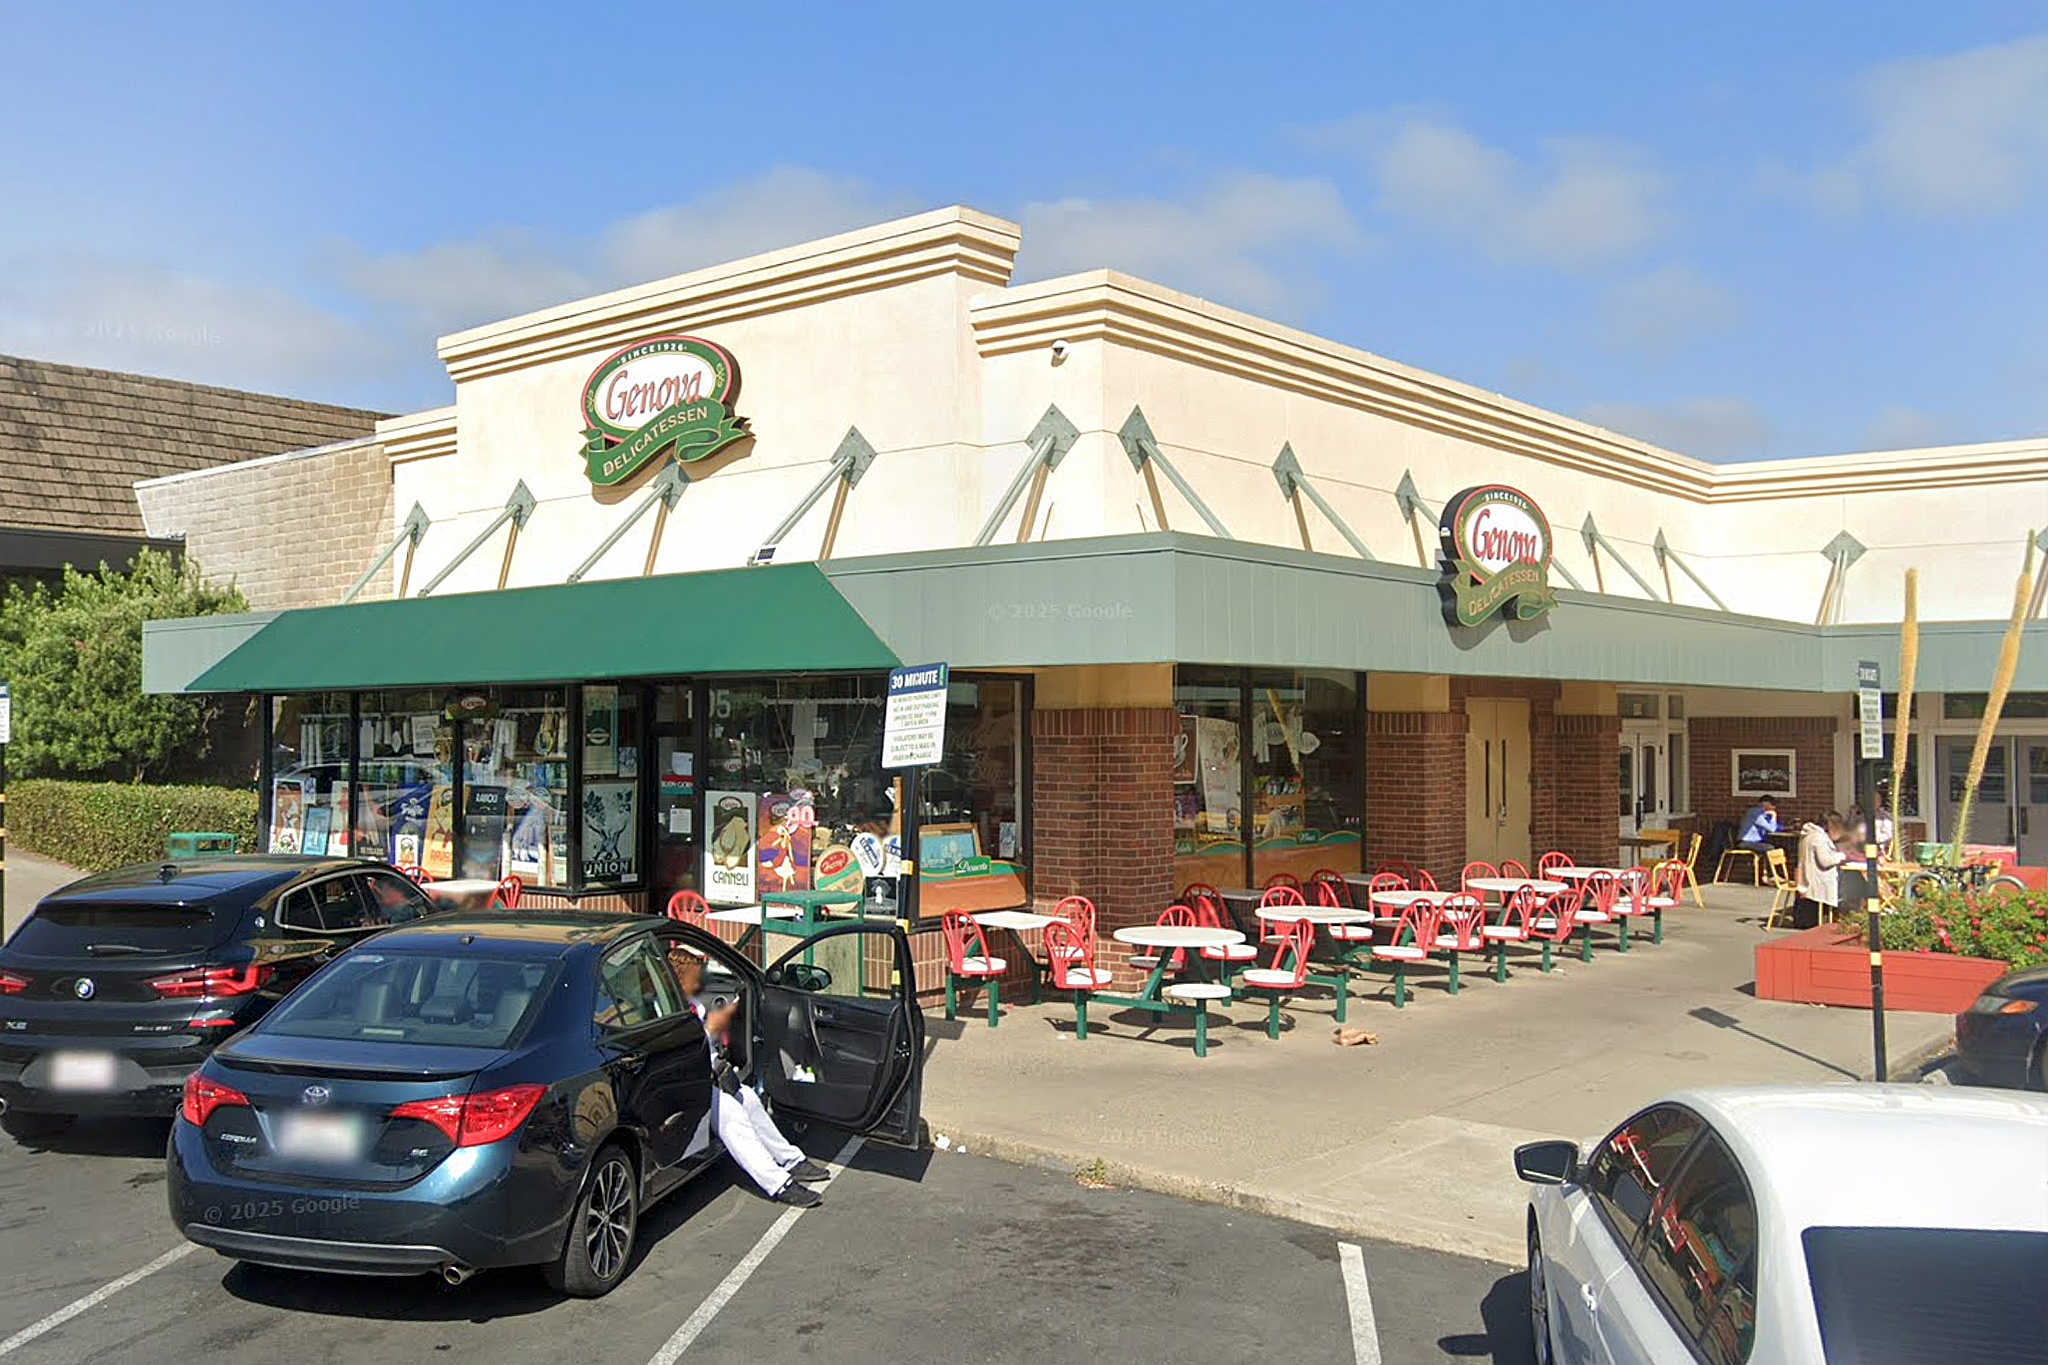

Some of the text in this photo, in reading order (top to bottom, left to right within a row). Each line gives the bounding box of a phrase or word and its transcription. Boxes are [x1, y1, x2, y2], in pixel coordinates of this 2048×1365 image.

[621, 343, 683, 363] SINCE 1926
[606, 370, 702, 422] Genova
[603, 406, 708, 476] DELICATESSEN
[1472, 508, 1537, 567] Genova
[1469, 570, 1540, 616] DELICATESSEN
[891, 675, 904, 689] 30
[904, 670, 938, 687] MINUTE
[583, 861, 628, 875] UNION
[712, 870, 749, 886] CANNOLI
